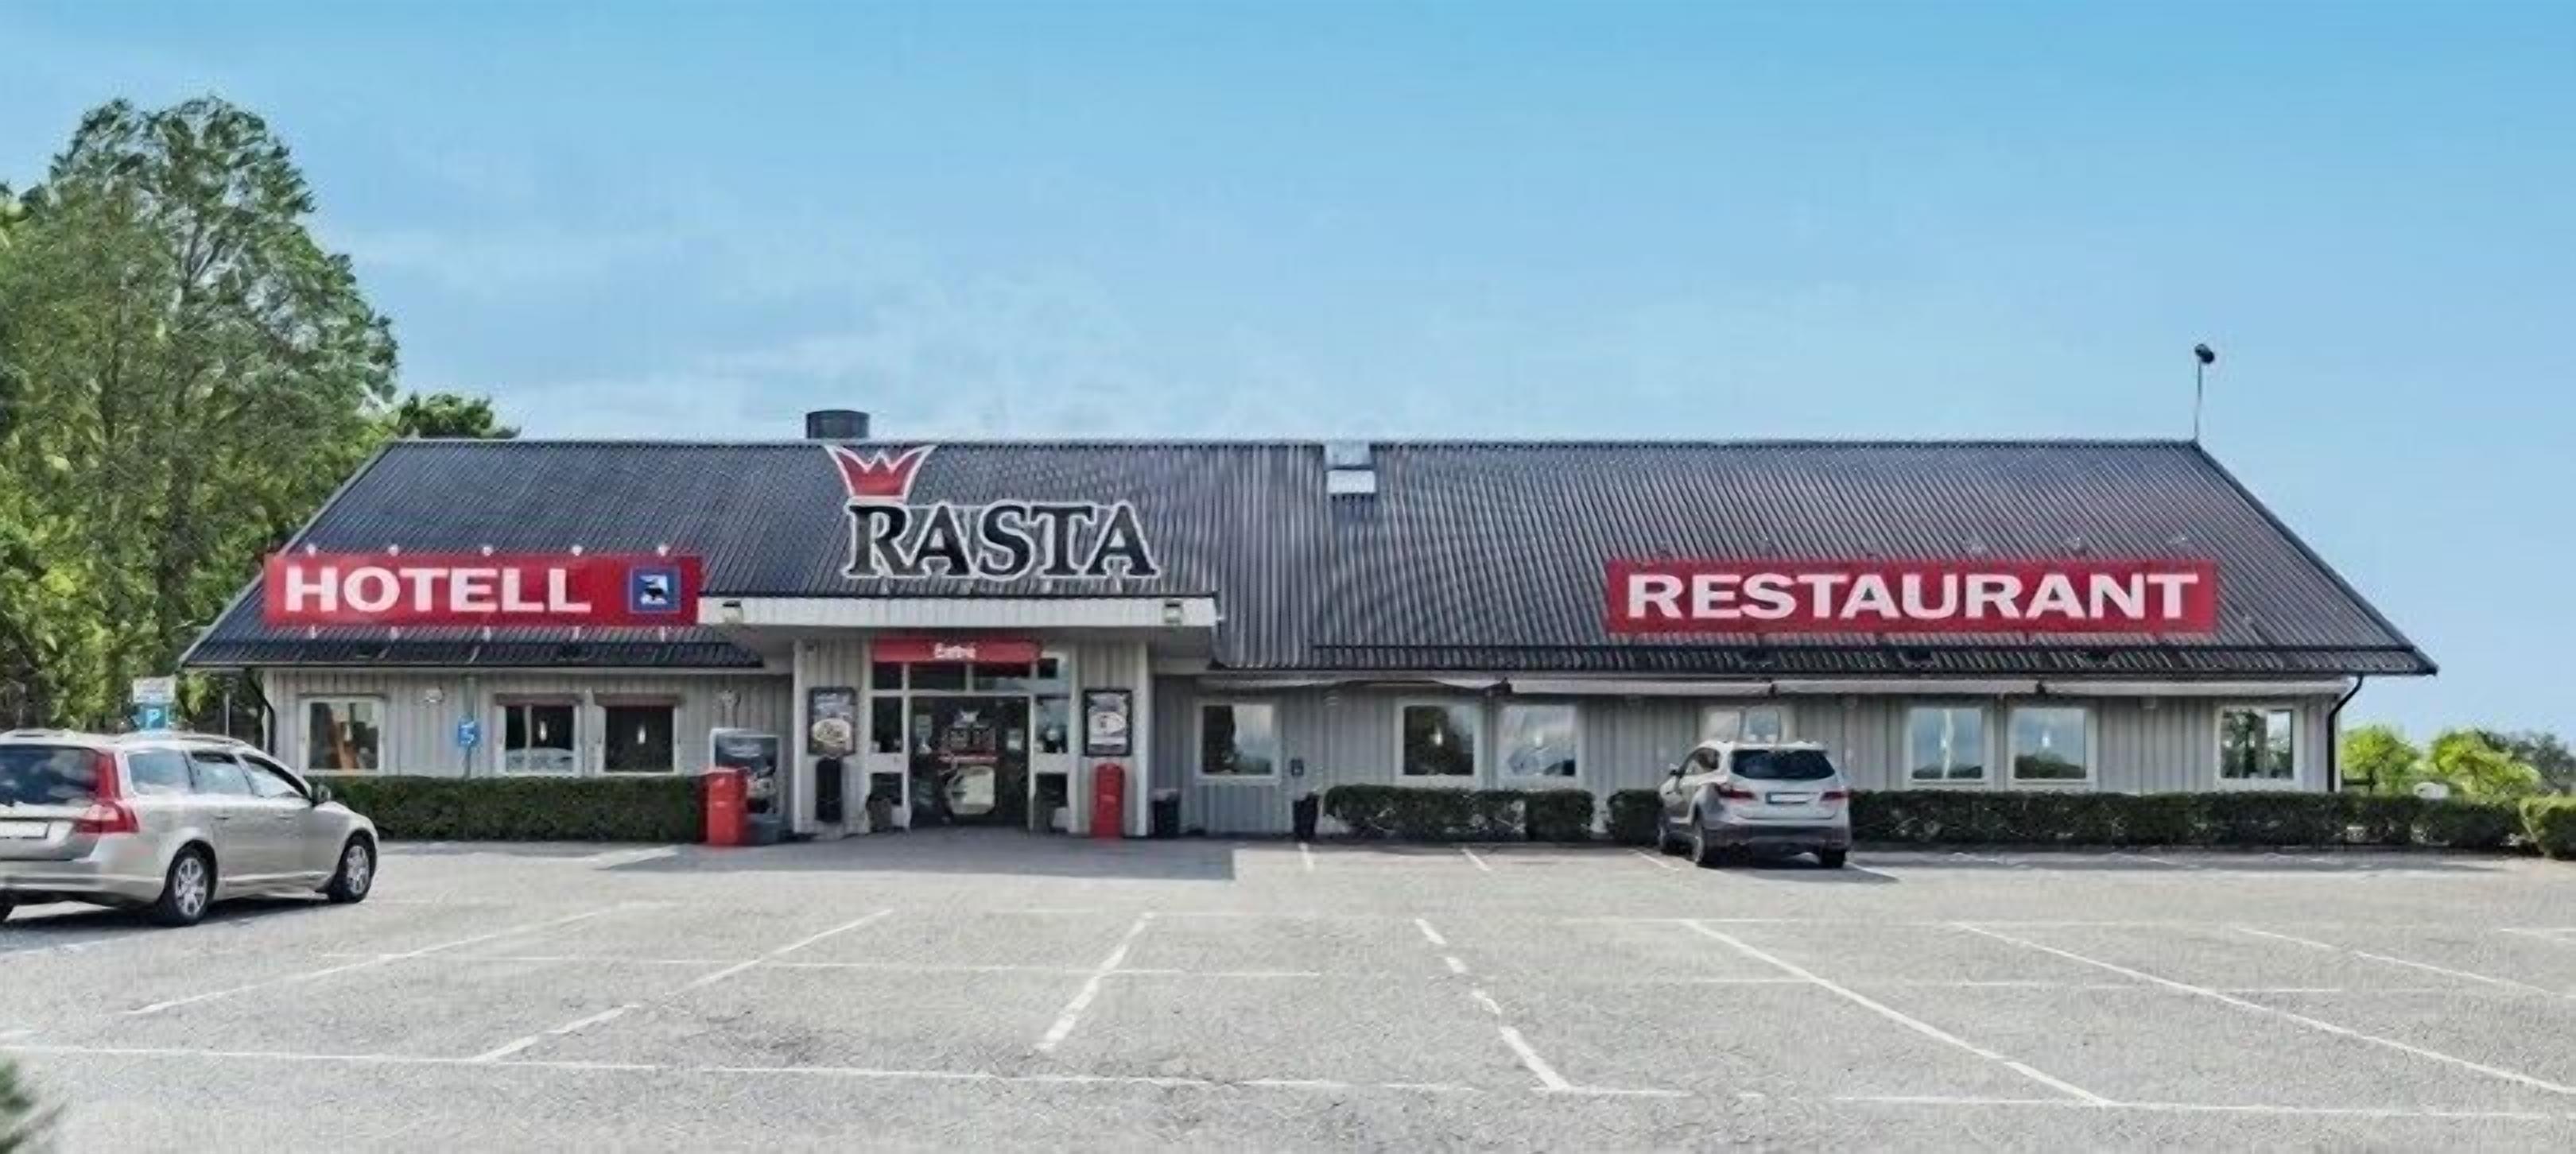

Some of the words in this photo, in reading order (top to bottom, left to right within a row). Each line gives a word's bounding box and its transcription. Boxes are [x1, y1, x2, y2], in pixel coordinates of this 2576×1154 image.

[842, 499, 1161, 580] RASTA
[284, 565, 592, 613] HOTELL
[1627, 573, 2199, 619] RESTAURANT
